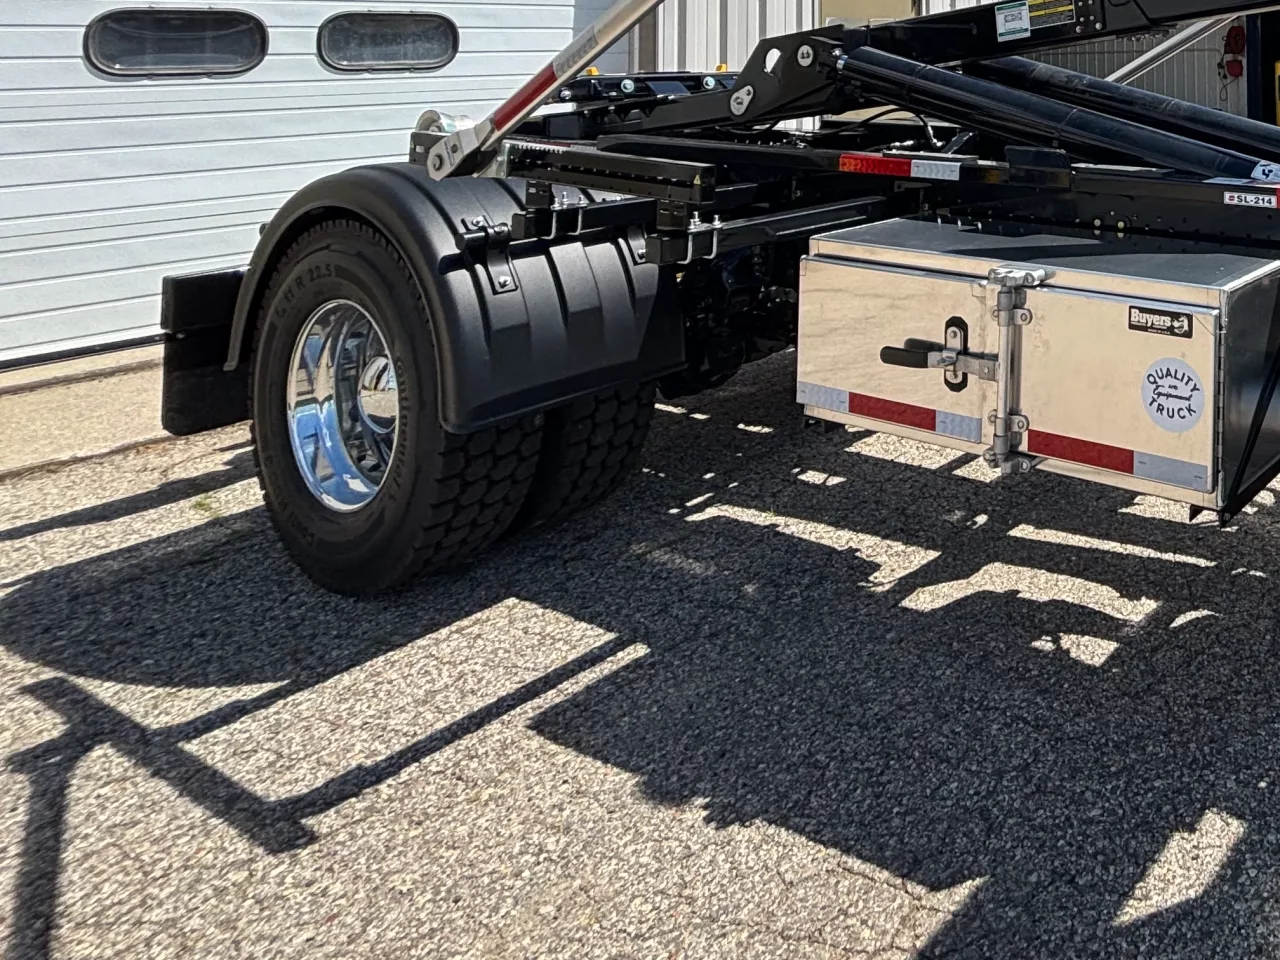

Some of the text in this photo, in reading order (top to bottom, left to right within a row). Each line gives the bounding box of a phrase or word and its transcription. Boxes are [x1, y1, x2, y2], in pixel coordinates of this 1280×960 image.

[1236, 194, 1273, 206] SL-214
[1130, 308, 1172, 327] Buyers
[1146, 367, 1201, 393] QUALITY
[1148, 395, 1197, 420] TRUCK
